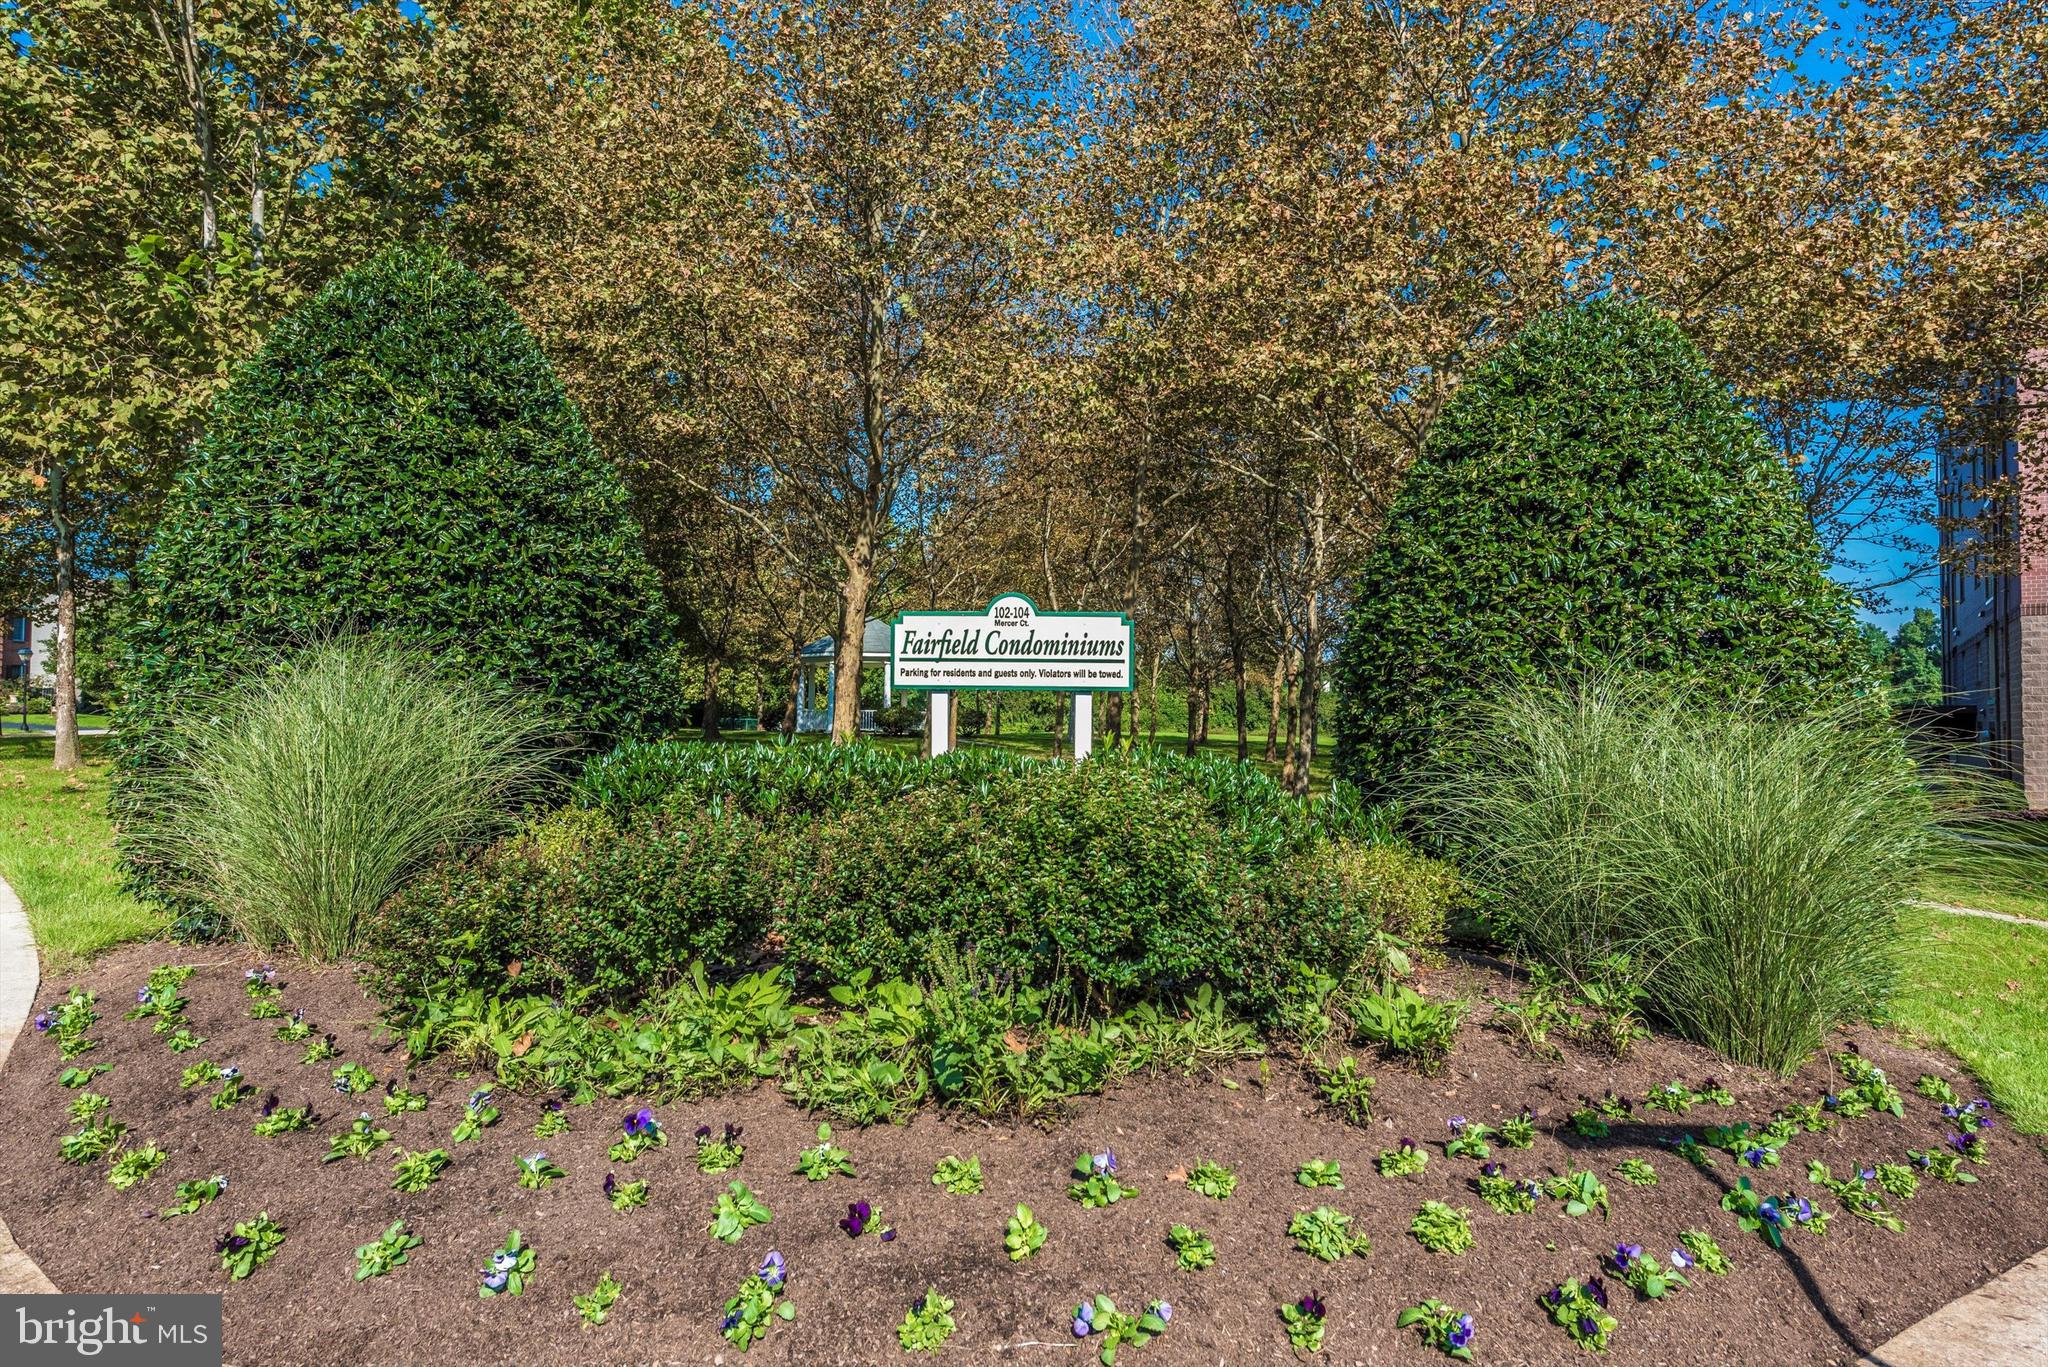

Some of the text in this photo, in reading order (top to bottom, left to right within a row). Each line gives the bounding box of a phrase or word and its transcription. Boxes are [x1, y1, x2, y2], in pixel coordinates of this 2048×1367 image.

[994, 607, 1030, 619] 102-104
[900, 629, 1125, 658] Fairfield Condominiums
[900, 668, 1123, 679] Parking for residents and guests only. Violators will be towed.
